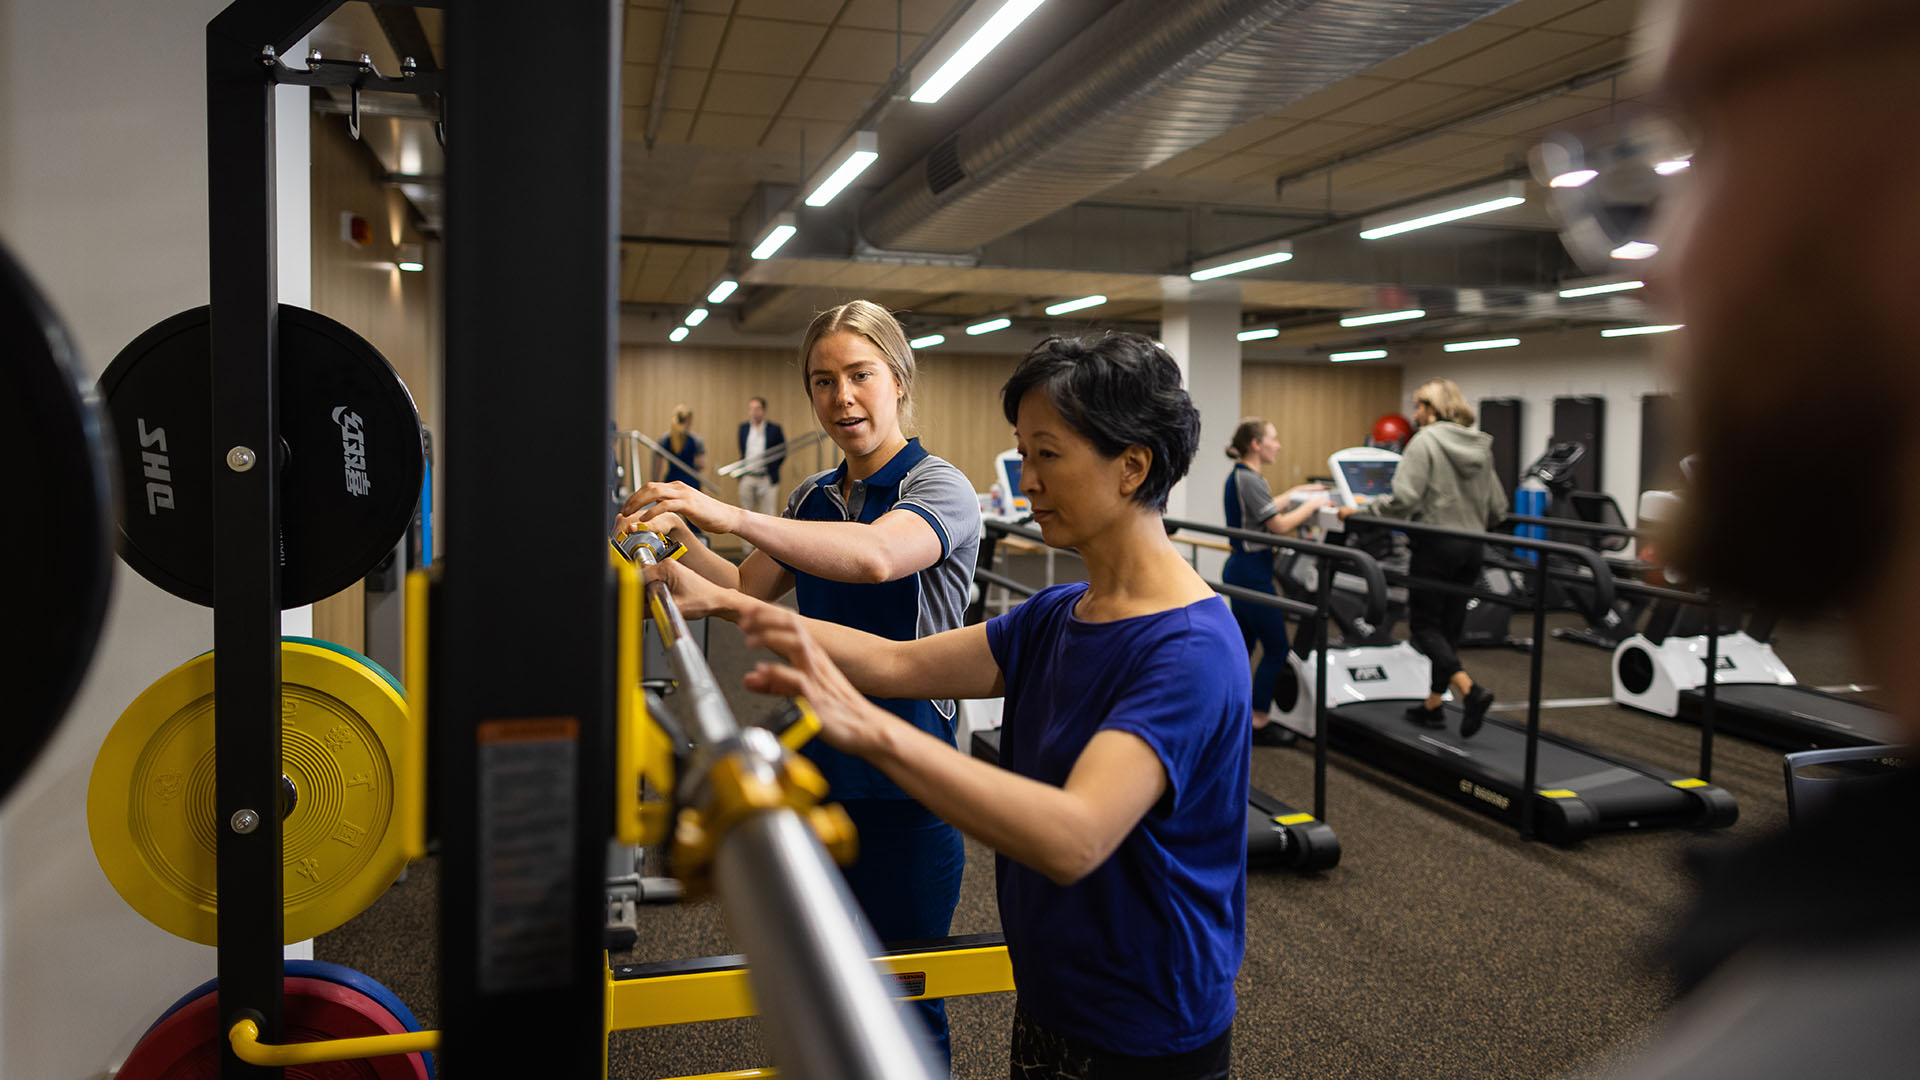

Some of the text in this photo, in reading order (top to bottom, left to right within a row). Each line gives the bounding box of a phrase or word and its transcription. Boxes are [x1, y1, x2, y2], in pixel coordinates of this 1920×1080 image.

[137, 418, 175, 515] DHS
[331, 406, 372, 497] 红双喜
